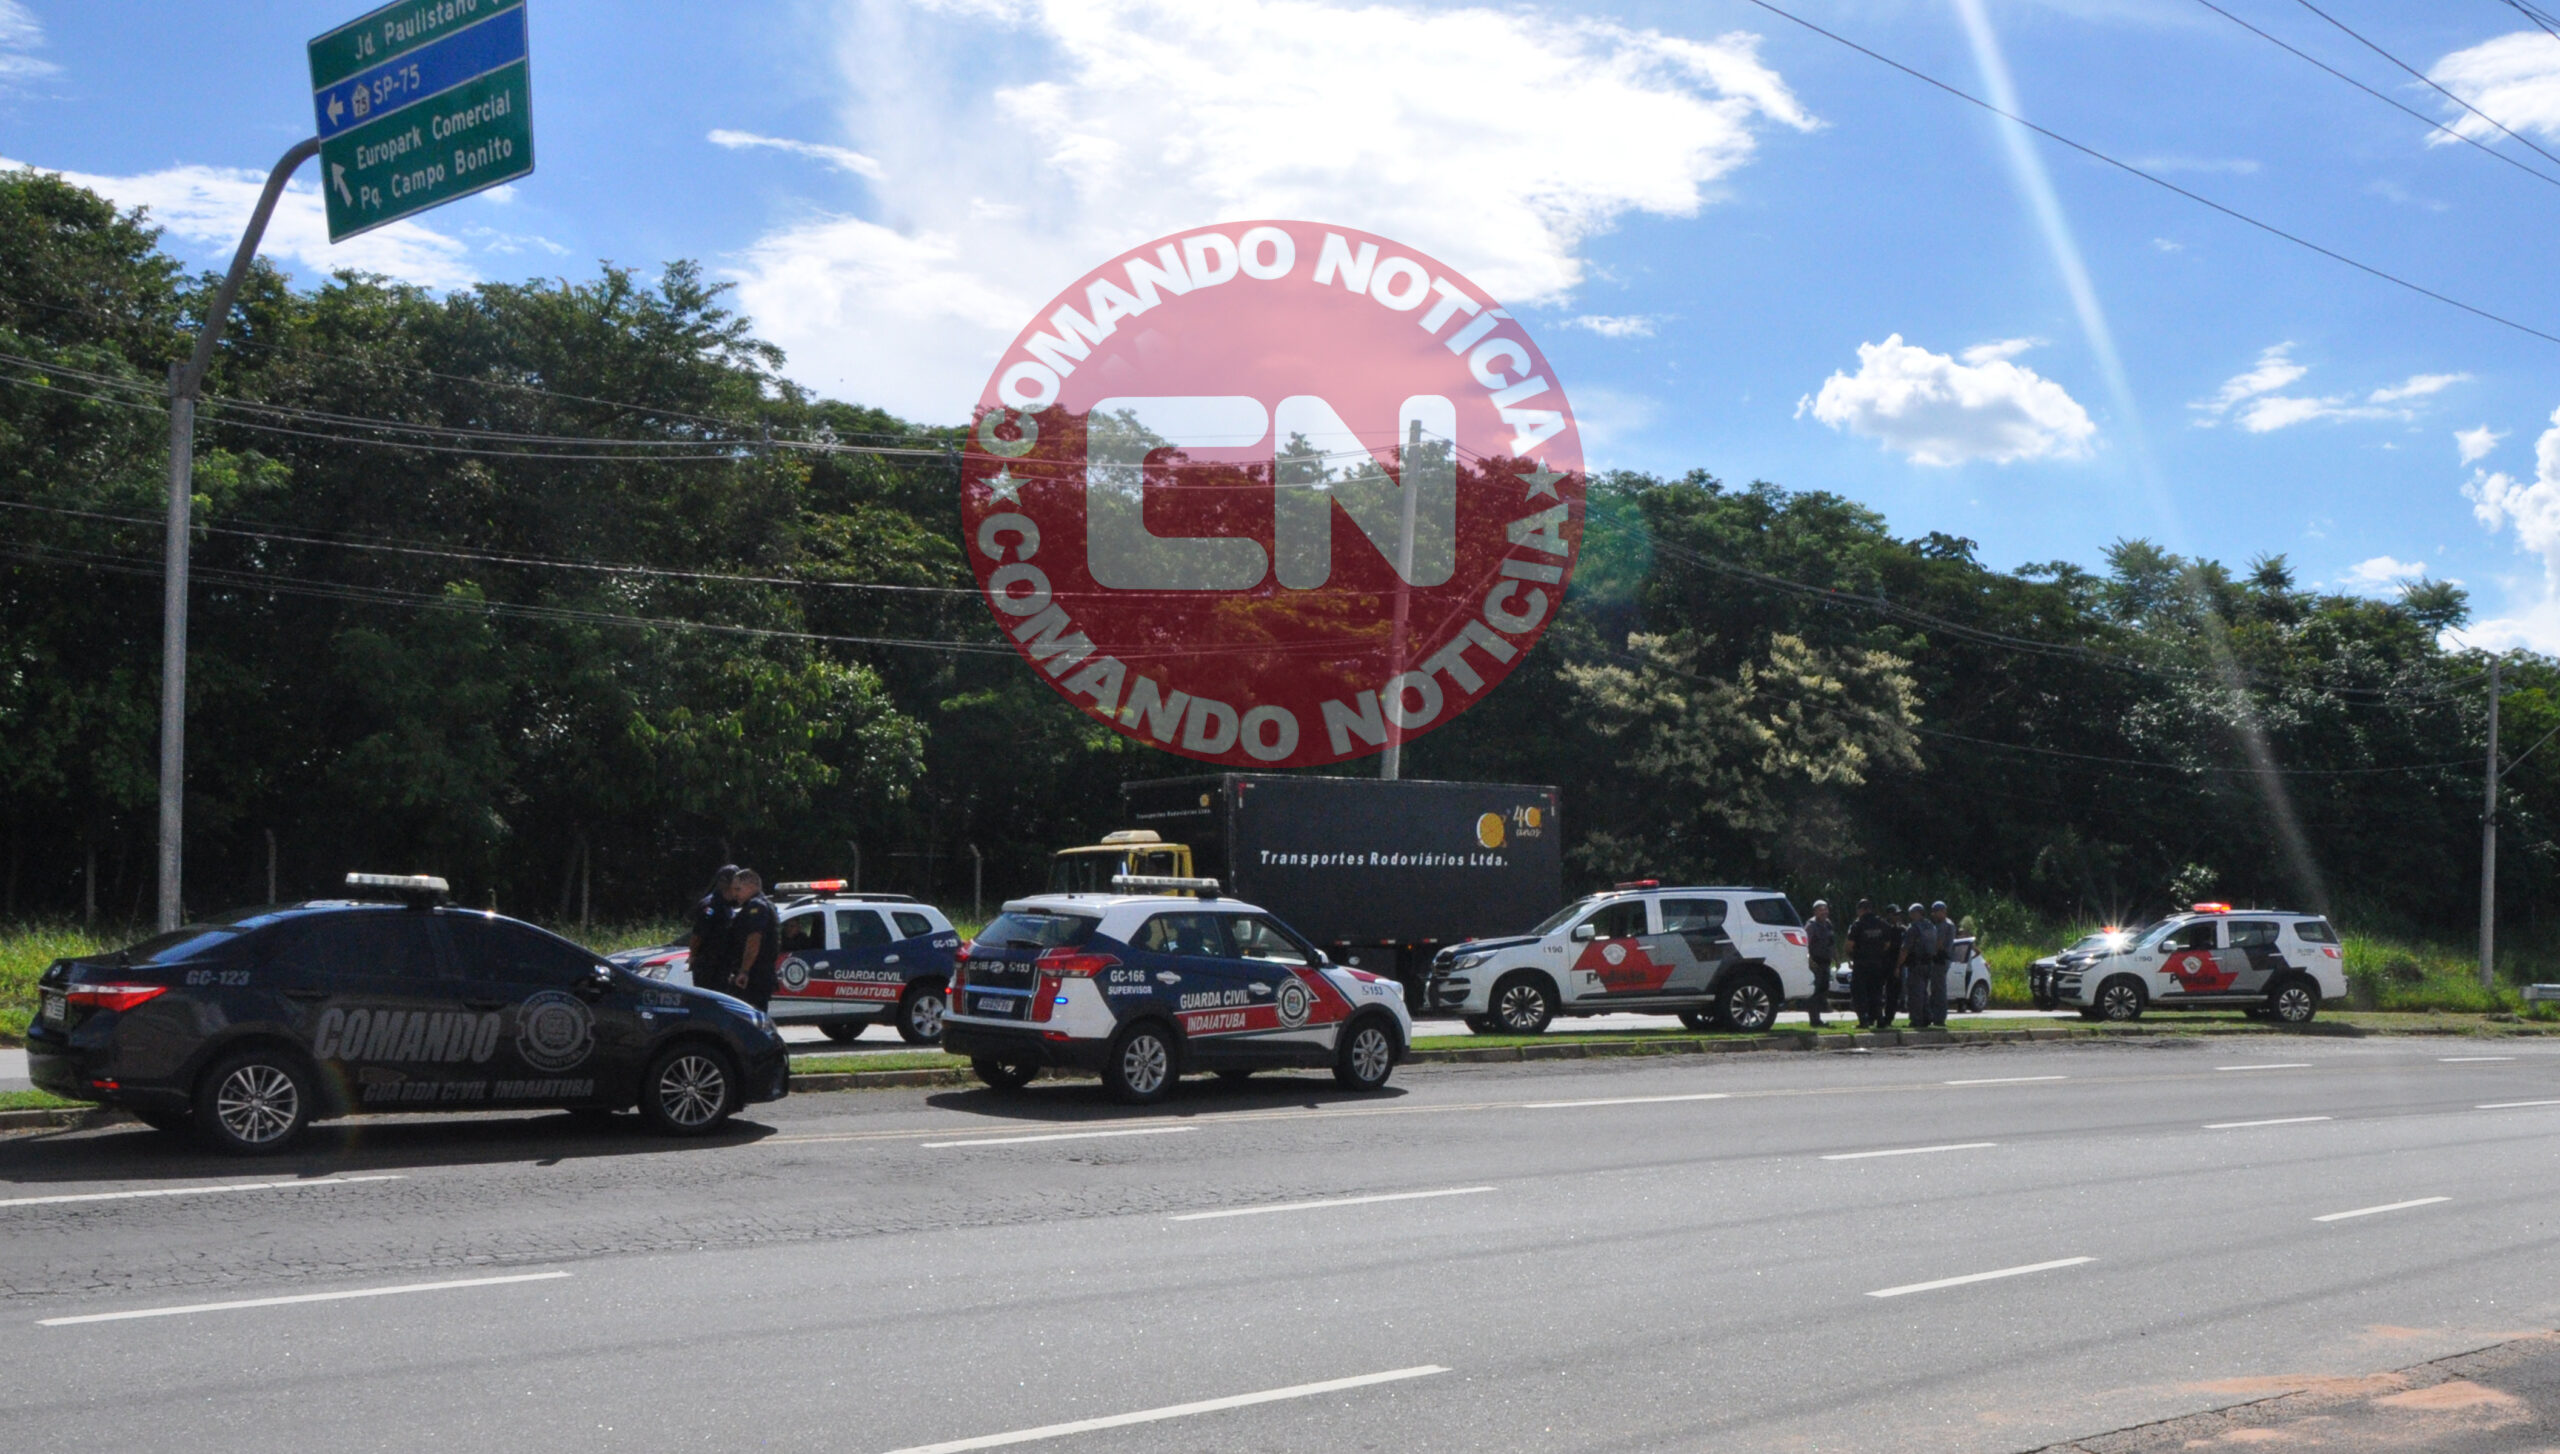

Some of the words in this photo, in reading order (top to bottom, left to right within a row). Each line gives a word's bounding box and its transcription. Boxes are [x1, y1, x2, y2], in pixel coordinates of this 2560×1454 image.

[384, 0, 477, 46] Paulistano
[373, 63, 421, 105] SP-75
[356, 125, 422, 171] Europark
[432, 89, 511, 141] Comercial
[391, 163, 445, 198] Campo
[454, 138, 512, 175] Bonito
[1260, 850, 1365, 868] Transportes
[1370, 850, 1464, 866] Rodoviários
[1470, 852, 1508, 866] Ltda.
[1548, 946, 1563, 954] 190
[834, 969, 876, 981] GUARDA
[876, 971, 903, 982] CIVIL
[1016, 962, 1031, 974] 153
[1110, 969, 1146, 983] GC-166
[186, 970, 250, 986] GC-123
[835, 985, 897, 998] INDAIATUBA
[1107, 985, 1153, 995] SUPERVISOR
[1180, 991, 1221, 1009] GUARDA
[1223, 989, 1251, 1006] CIVIL
[1369, 985, 1384, 996] 153
[1187, 1013, 1247, 1032] INDAIATUBA
[313, 1007, 501, 1063] COMANDO
[363, 1081, 440, 1101] GUARDA
[440, 1080, 488, 1099] CIVIL
[493, 1078, 595, 1098] INDAIATUBA
